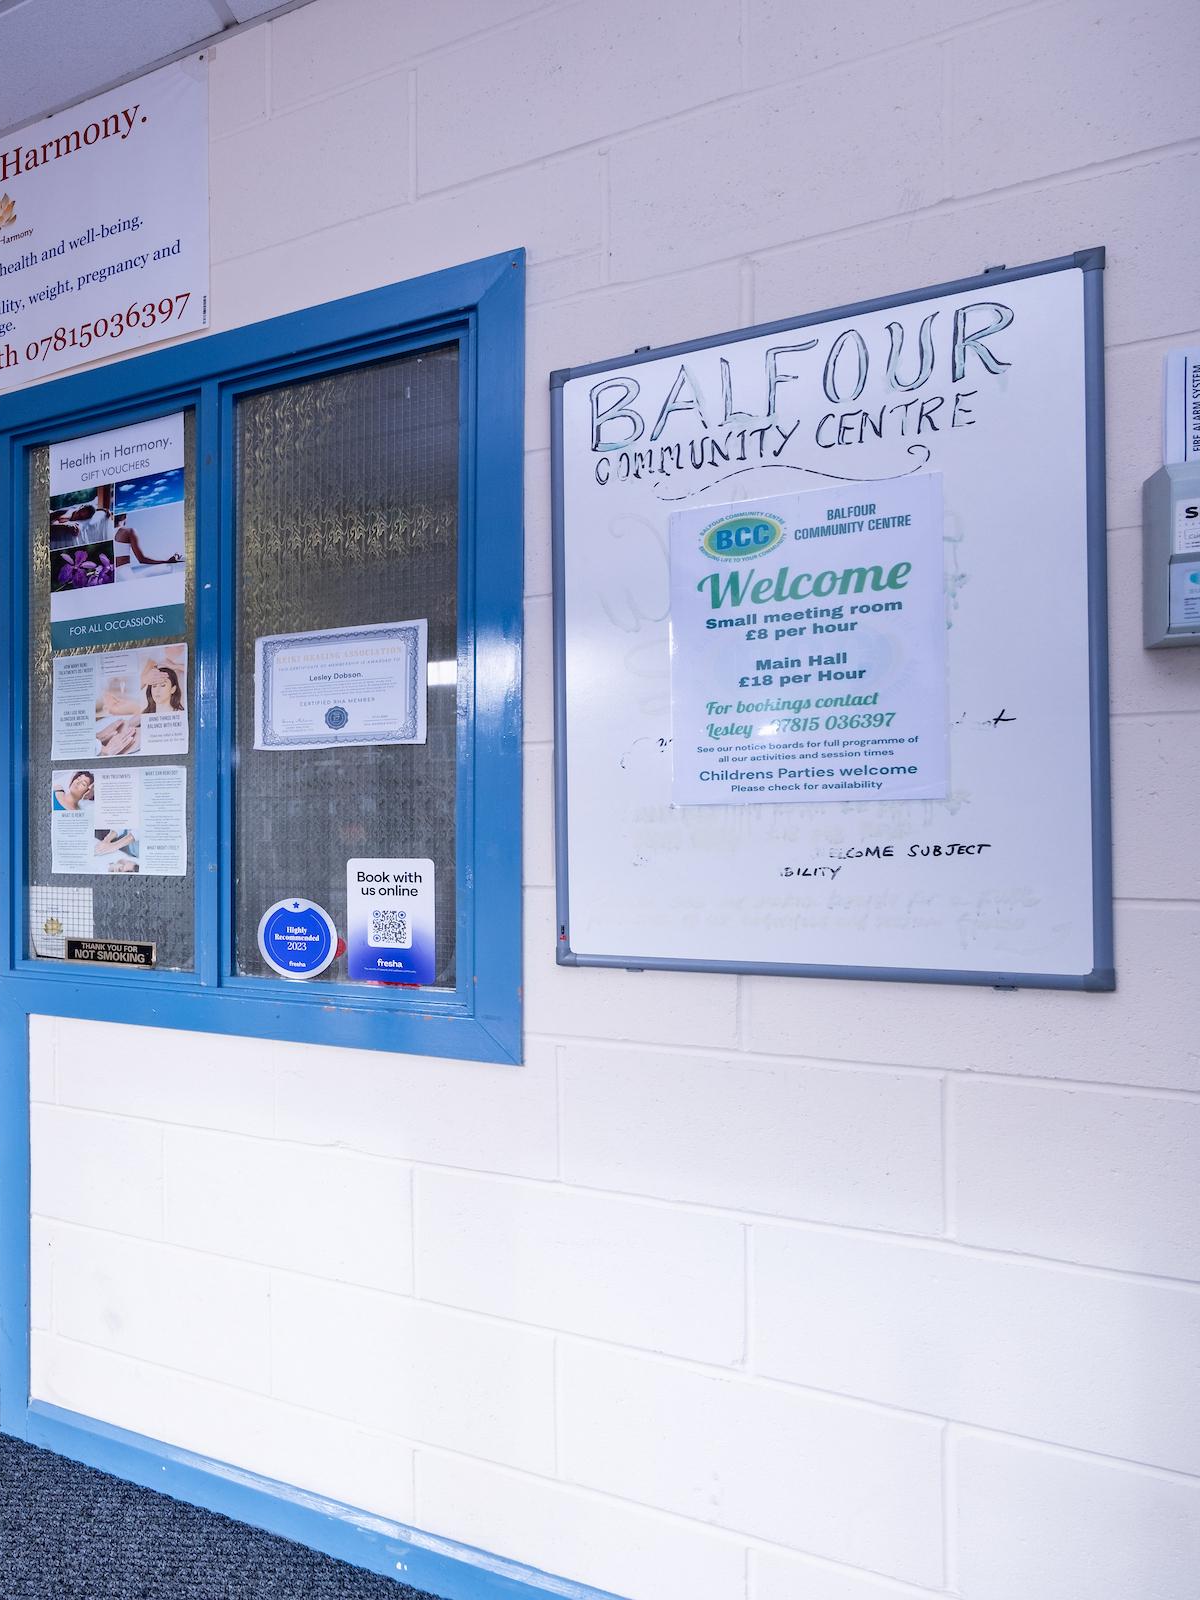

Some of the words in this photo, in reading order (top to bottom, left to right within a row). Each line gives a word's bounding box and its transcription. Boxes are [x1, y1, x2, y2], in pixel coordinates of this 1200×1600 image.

[0, 104, 147, 182] Harmony.
[0, 251, 38, 277] health
[41, 240, 65, 261] and
[68, 215, 143, 250] well-being.
[28, 280, 74, 305] weight,
[77, 252, 149, 290] pregnancy
[152, 239, 181, 261] and
[26, 292, 191, 361] 07815036397
[590, 301, 1014, 452] BALFOUR
[595, 420, 800, 485] COMMUNITY
[815, 390, 978, 449] CENTRE
[60, 452, 96, 470] Health
[100, 450, 110, 461] in
[114, 437, 173, 458] Harmony.
[81, 470, 99, 482] GIFT
[101, 458, 150, 477] VOUCHERS
[826, 503, 876, 521] BALFOUR
[716, 523, 769, 551] BCC
[794, 520, 864, 540] COMMUNITY
[868, 514, 911, 531] CENTRE
[697, 561, 912, 609] Welcome
[69, 625, 87, 636] FOR
[88, 622, 103, 633] ALL
[104, 614, 166, 632] OCCASSIONS.
[706, 613, 757, 629] Small
[764, 605, 844, 625] meeting
[850, 601, 903, 615] room
[745, 628, 768, 641] £8
[775, 625, 807, 640] per
[812, 620, 858, 634] hour
[756, 657, 801, 671] Main
[808, 652, 848, 667] Hall
[309, 674, 331, 682] Lesley
[739, 675, 773, 688] £18
[780, 671, 812, 687] per
[818, 668, 866, 682] Hour
[706, 701, 732, 716] For
[736, 697, 811, 714] bookings
[815, 691, 879, 709] contact
[706, 722, 753, 740] Lesley
[825, 712, 896, 730] 036397
[697, 745, 715, 754] See
[735, 742, 767, 751] notice
[769, 740, 804, 750] boards
[806, 739, 821, 748] for
[823, 738, 840, 747] full
[842, 736, 905, 748] programme
[907, 735, 919, 744] of
[699, 769, 773, 782] Childrens
[778, 766, 835, 779] Parties
[839, 764, 918, 776] welcome
[907, 843, 991, 857] SUBJECT
[357, 871, 389, 883] Book
[393, 871, 422, 883] with
[361, 886, 375, 896] us
[378, 885, 418, 897] online
[274, 932, 320, 941] Recommended
[286, 926, 307, 936] Highly
[74, 949, 96, 959] NOT
[97, 951, 145, 963] SMOKING
[81, 942, 106, 950] THANK
[107, 944, 122, 952] YOU
[124, 945, 138, 953] FOR
[287, 942, 307, 951] 2023
[377, 958, 403, 968] fresha
